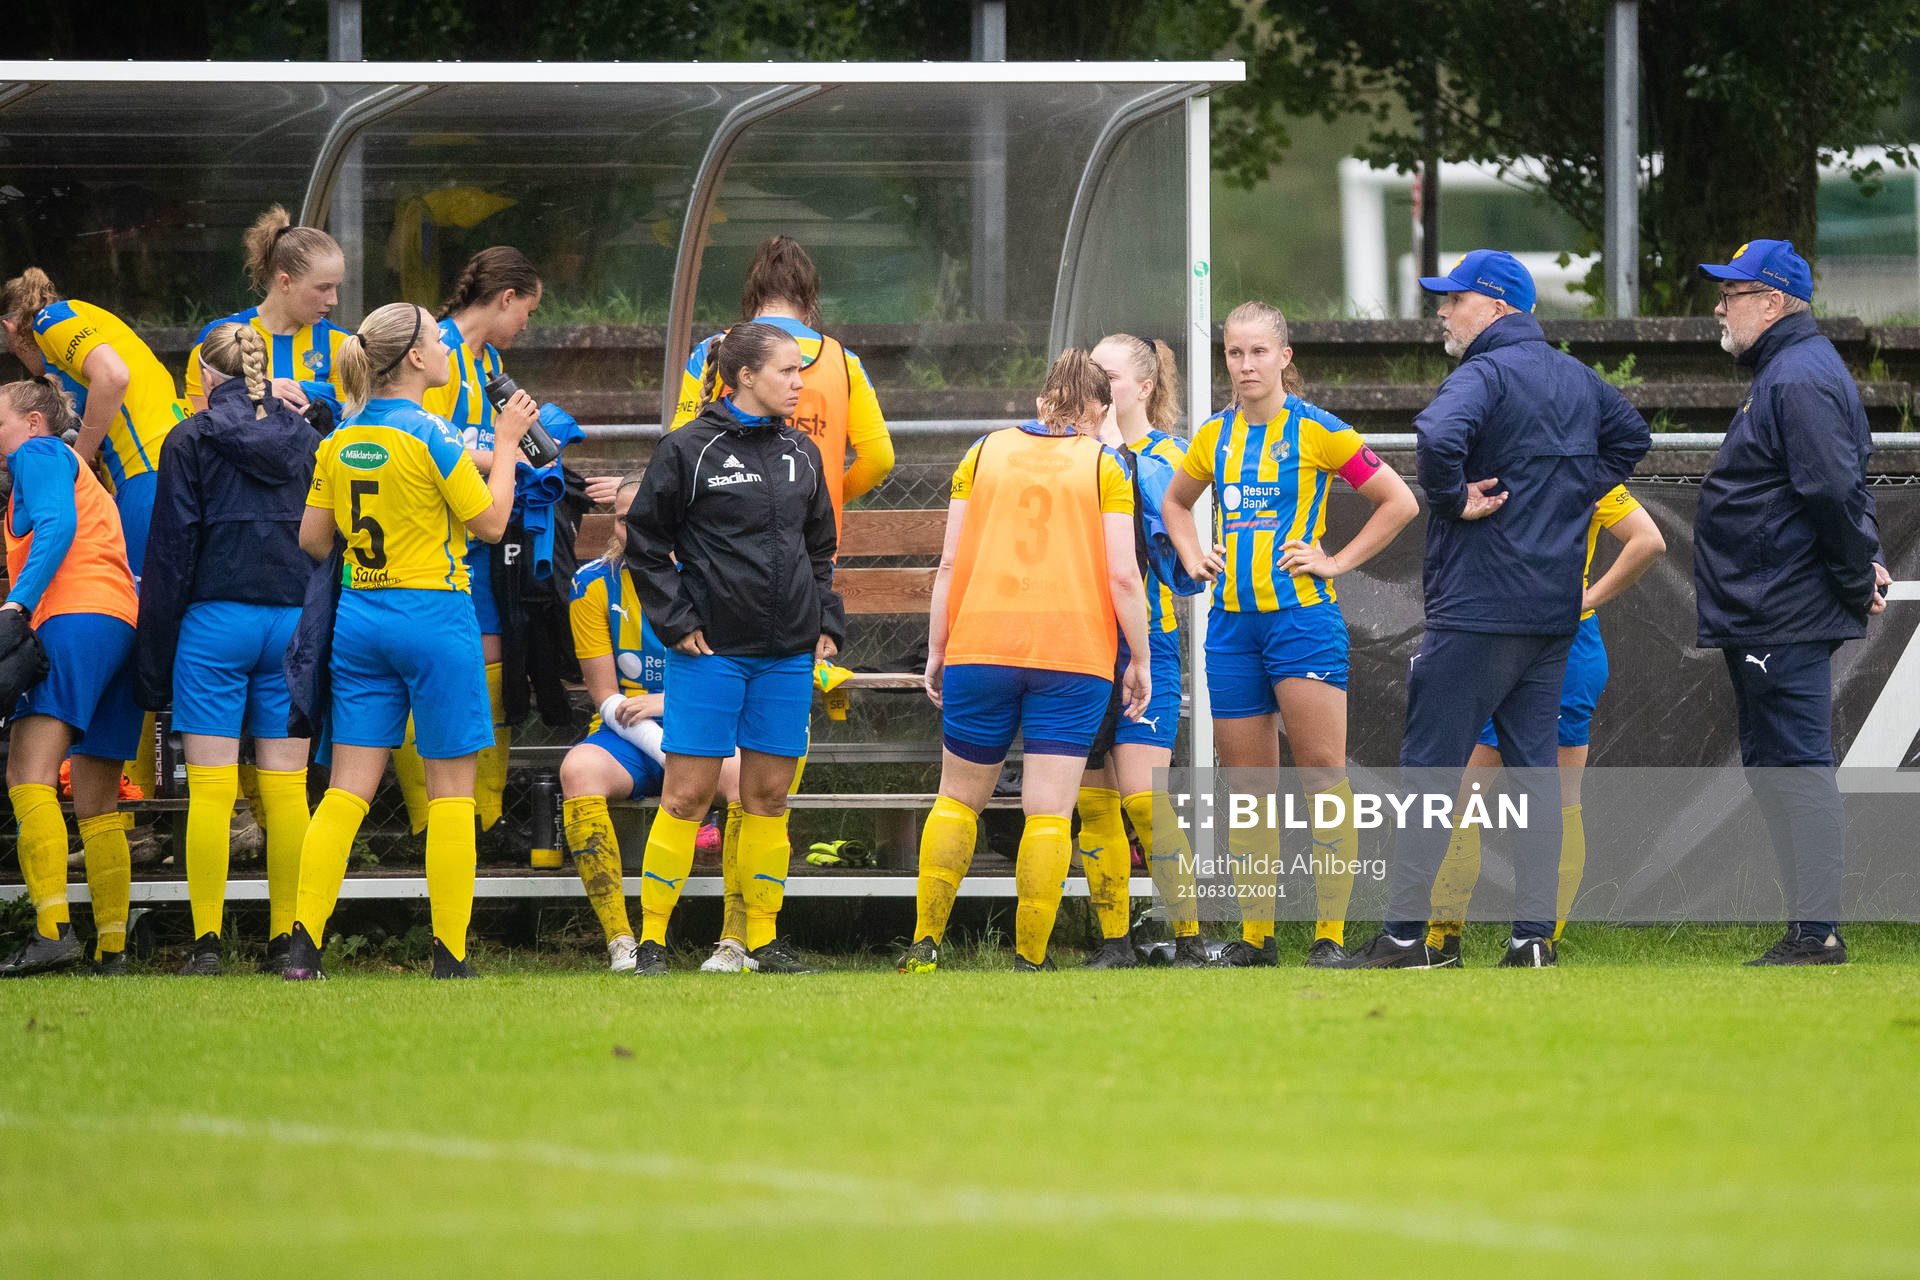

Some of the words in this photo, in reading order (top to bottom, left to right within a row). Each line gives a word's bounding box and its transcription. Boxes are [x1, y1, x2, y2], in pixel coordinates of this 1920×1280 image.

[707, 471, 762, 488] stadium
[1242, 484, 1281, 497] Resurs
[1242, 498, 1268, 509] Bank
[350, 480, 388, 569] 5
[1015, 484, 1053, 567] 3
[353, 566, 389, 583] Solid
[155, 721, 163, 786] stadium
